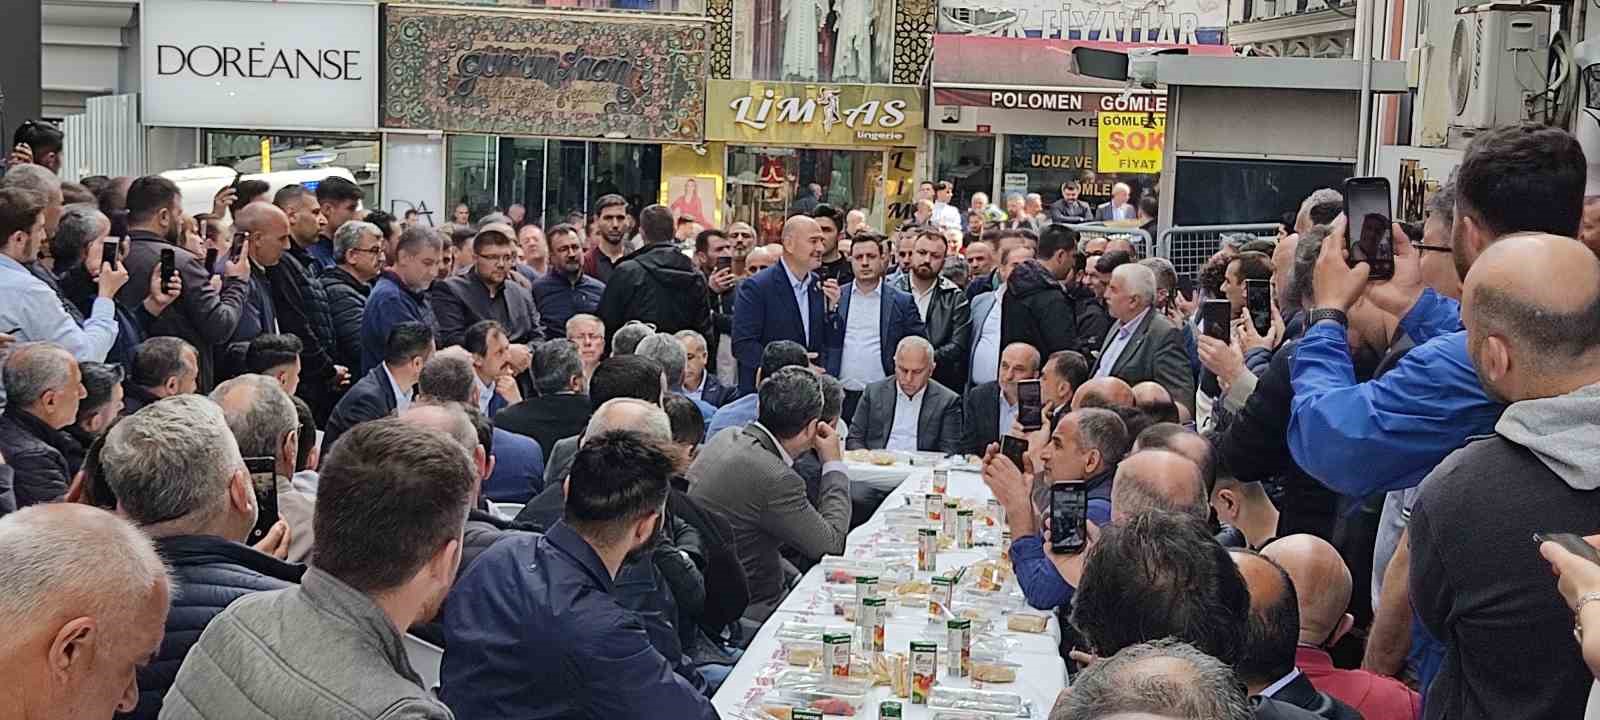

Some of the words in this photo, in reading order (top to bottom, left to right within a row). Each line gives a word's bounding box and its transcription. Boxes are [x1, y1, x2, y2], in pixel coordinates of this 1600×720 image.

[991, 91, 1082, 110] POLOMEN
[856, 130, 904, 141] lingerie
[1109, 130, 1165, 155] ŞOK
[1031, 153, 1071, 169] UCUZ
[1074, 155, 1093, 169] VE
